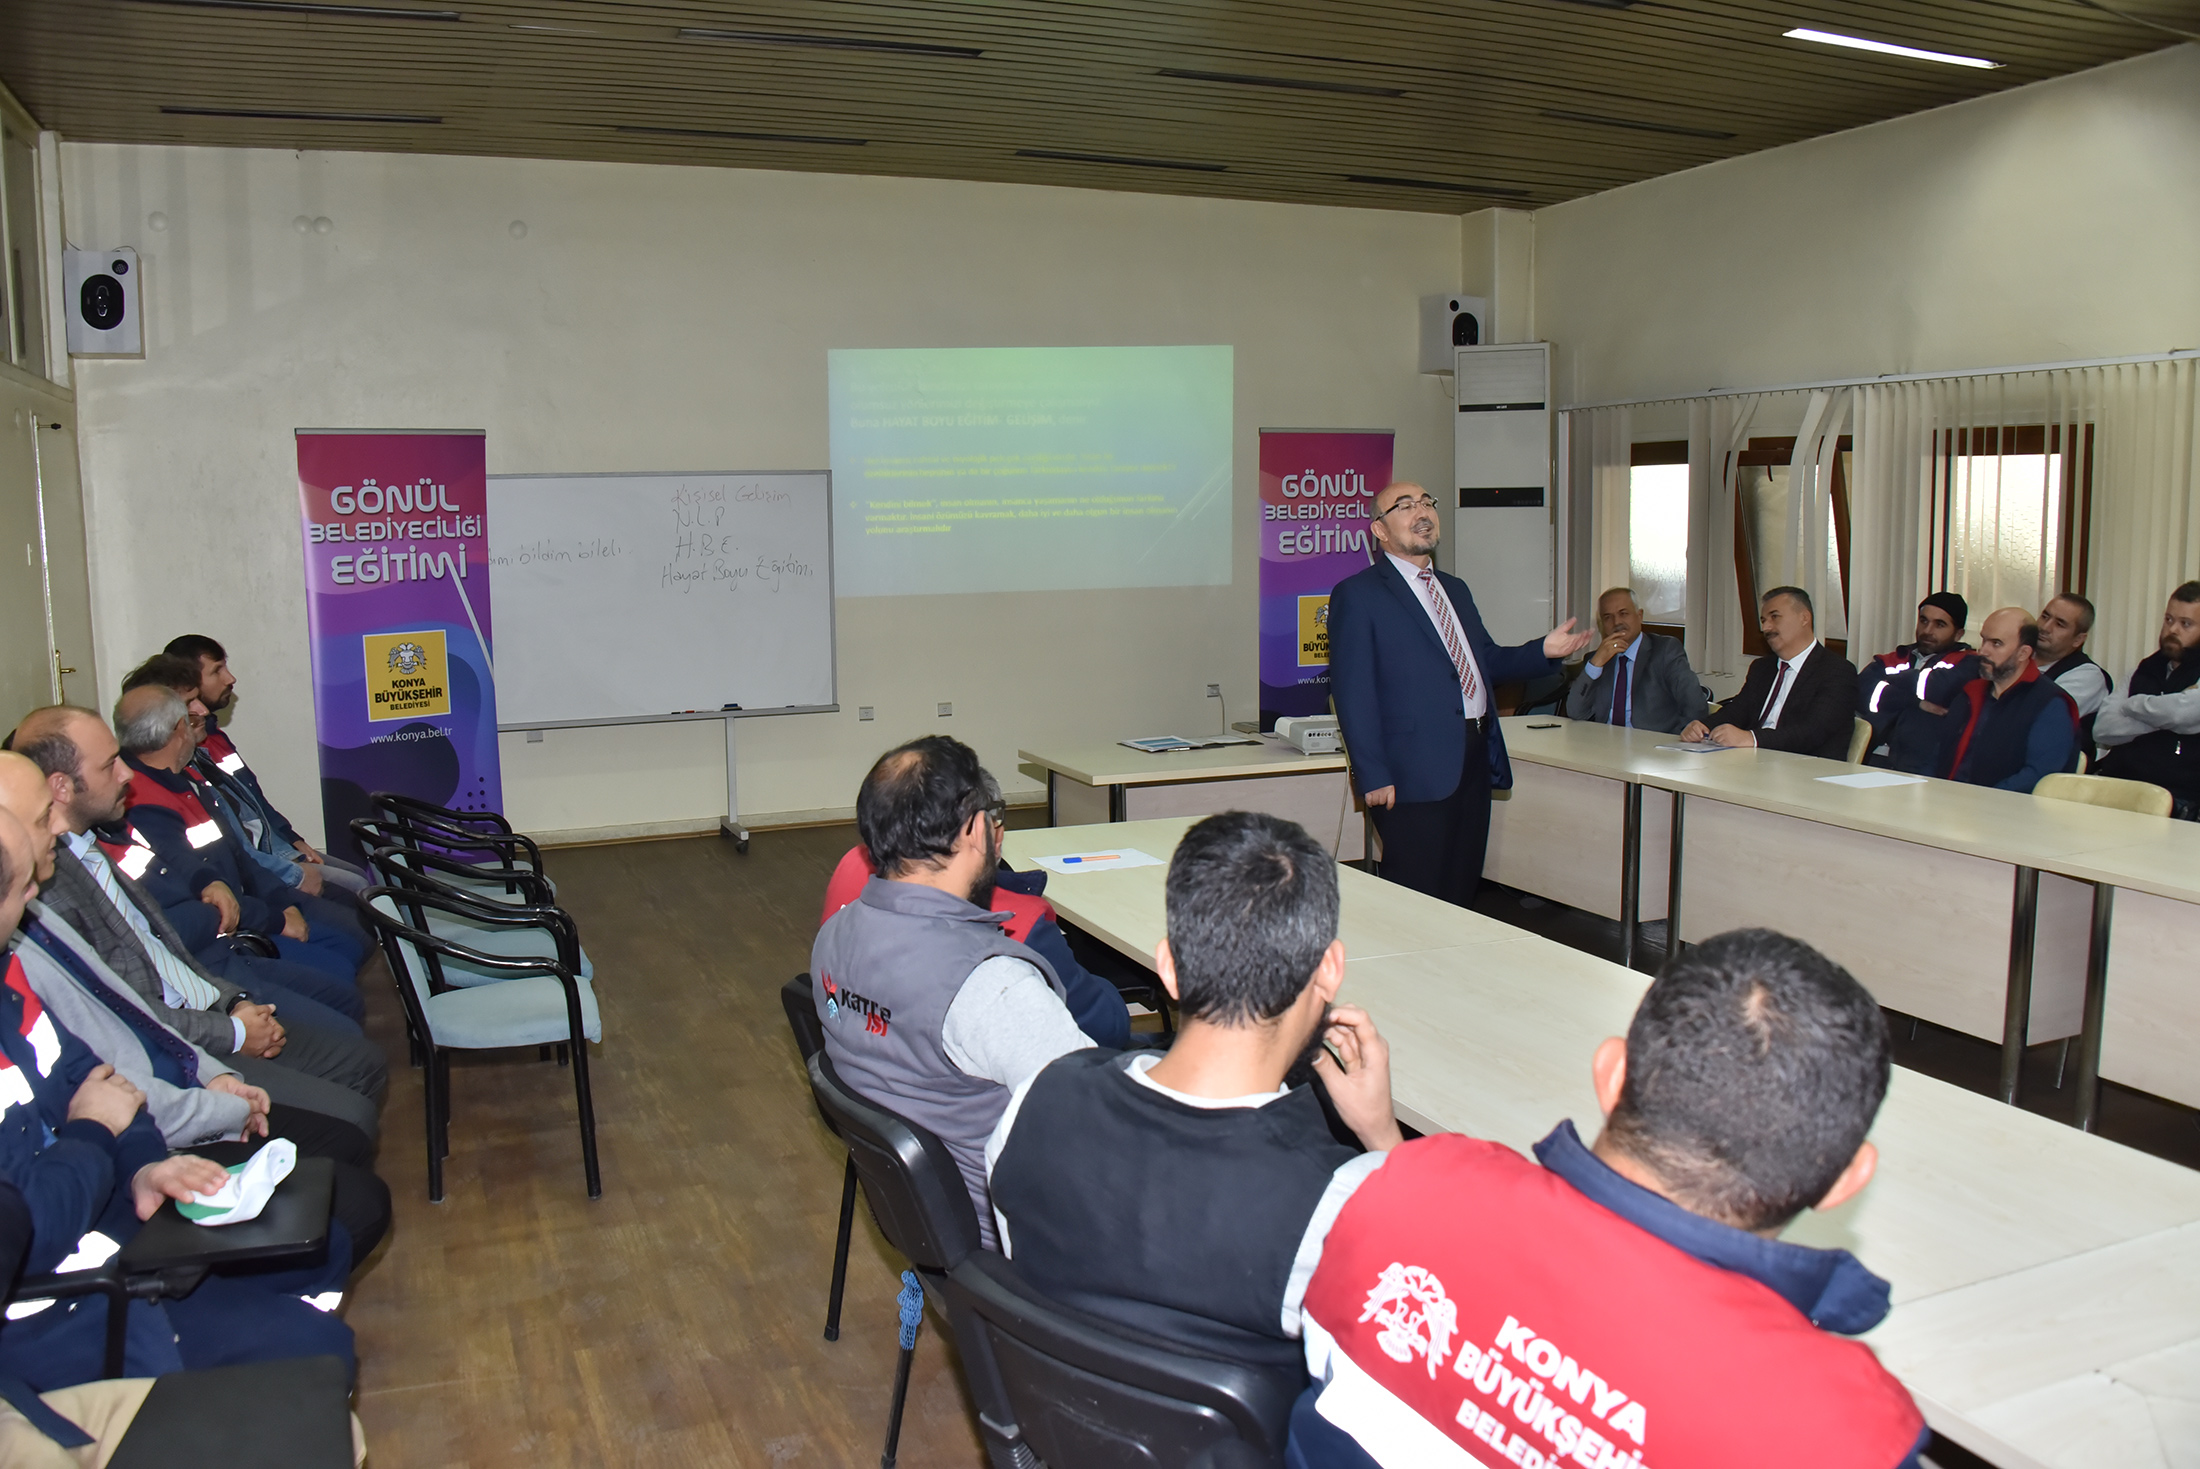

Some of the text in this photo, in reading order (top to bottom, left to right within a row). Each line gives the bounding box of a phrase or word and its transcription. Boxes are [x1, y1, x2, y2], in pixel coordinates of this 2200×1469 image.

[331, 478, 460, 515] GÖNÜL
[1281, 469, 1374, 498] GÖNÜL
[1265, 500, 1370, 520] BELEDİYECİL
[309, 514, 482, 543] BELEDİYECİLİĞİ
[331, 543, 467, 585] EĞİTİMİ
[374, 686, 443, 703] BÜYÜKŞEHİR
[392, 678, 426, 688] KONYA
[390, 700, 430, 710] BELEDİYESİ
[370, 727, 452, 744] www.konya.bel.tr
[1494, 1315, 1647, 1446] KONYA
[1453, 1340, 1653, 1469] BÜYÜKŞEHİ
[1455, 1398, 1563, 1469] BELEDİ
